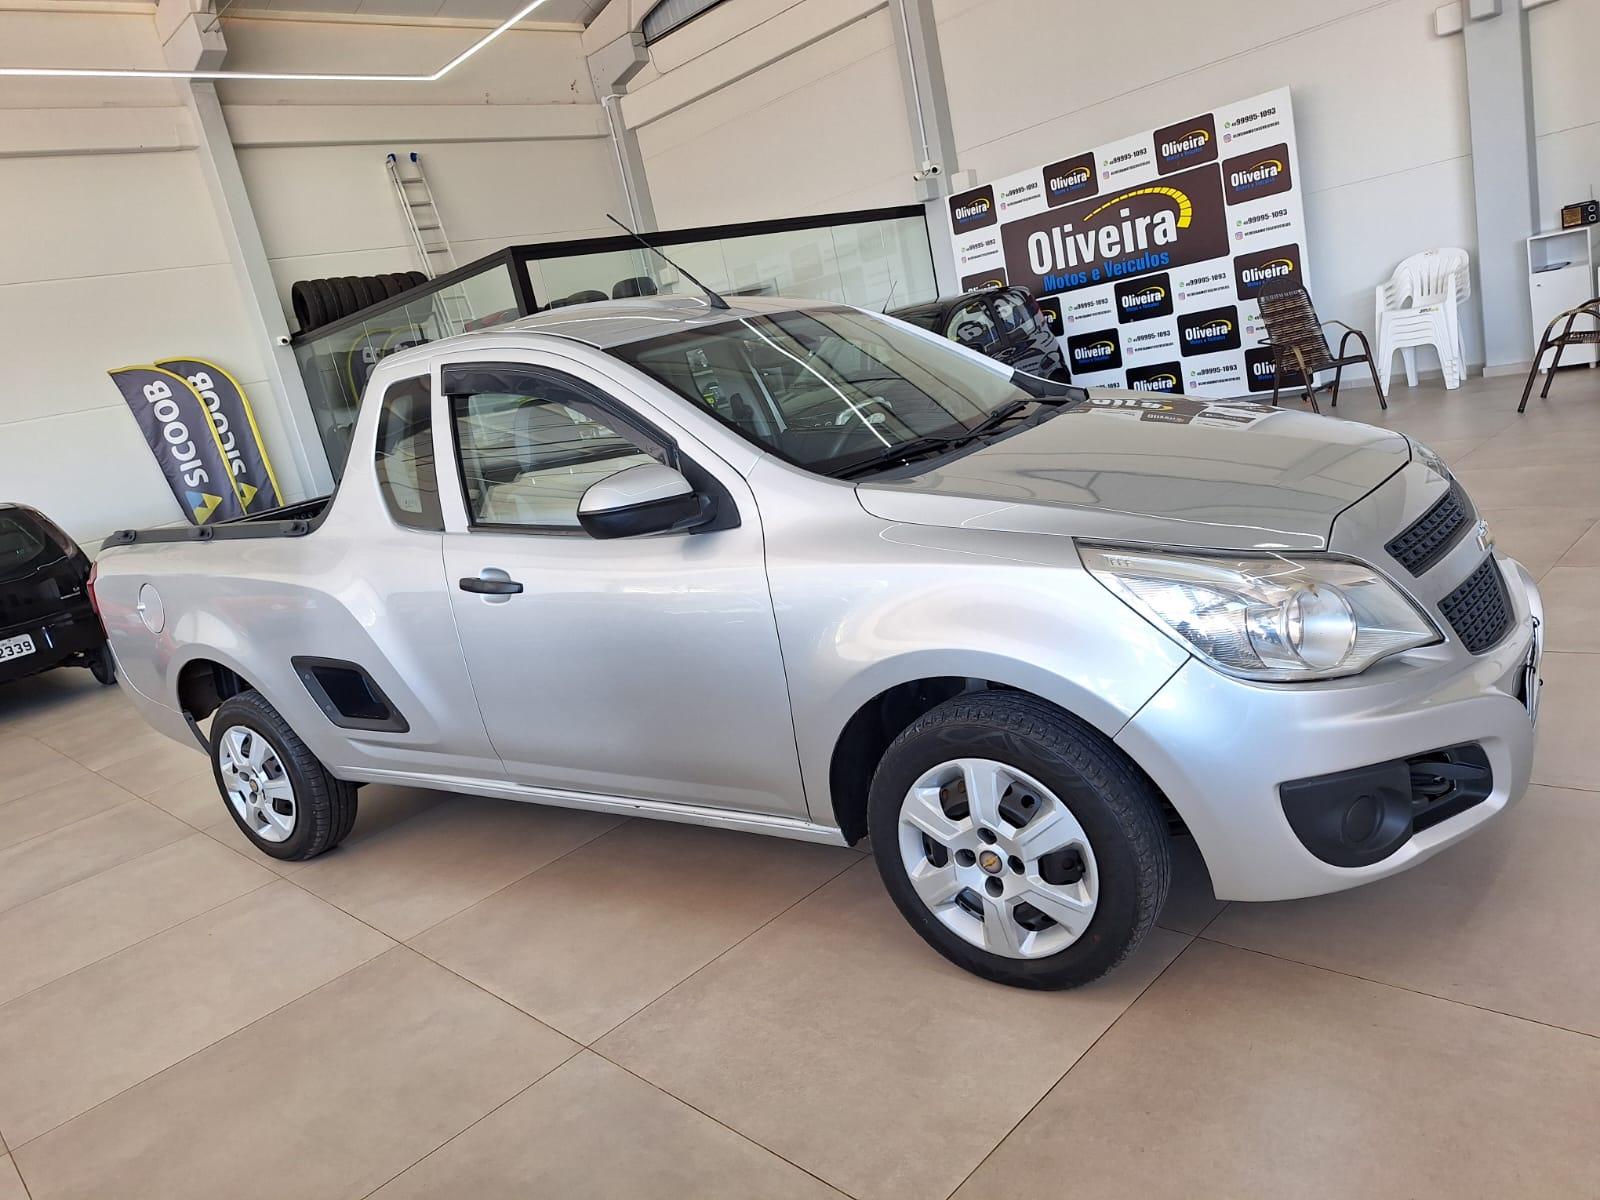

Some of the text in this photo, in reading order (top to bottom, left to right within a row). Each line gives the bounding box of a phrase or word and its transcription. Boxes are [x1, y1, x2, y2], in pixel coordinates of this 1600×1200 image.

[1162, 135, 1205, 157] Oliveira
[1050, 171, 1087, 191] Oliveira
[1231, 165, 1278, 187] Oliveira
[955, 203, 988, 220] Oliveira
[1027, 207, 1178, 275] Oliveira
[1043, 251, 1170, 292] Motos e Veículos
[1242, 263, 1289, 283] Oliveira
[1121, 291, 1162, 308] Oliveira
[1184, 324, 1228, 341] Oliveira
[1074, 345, 1112, 360] Oliveira
[1133, 378, 1173, 392] Oliveira
[143, 380, 209, 488] SICOOB
